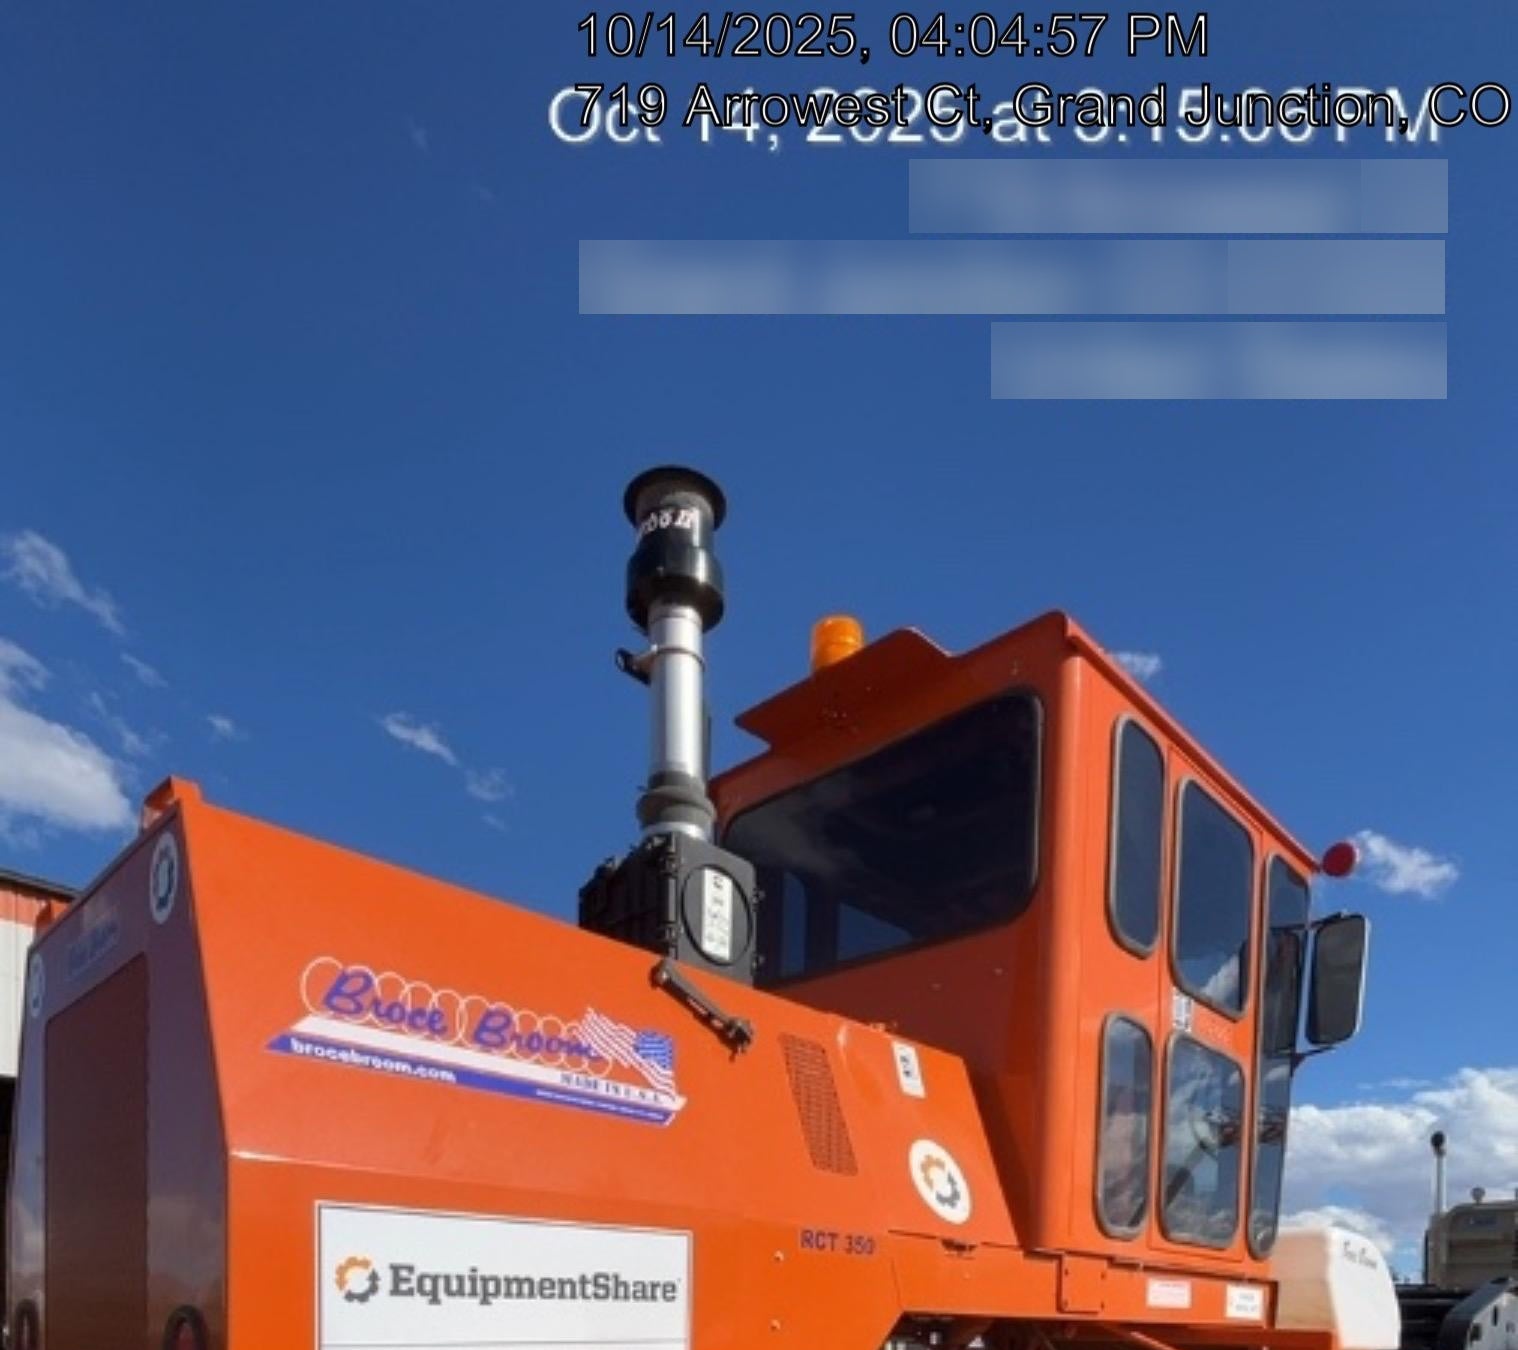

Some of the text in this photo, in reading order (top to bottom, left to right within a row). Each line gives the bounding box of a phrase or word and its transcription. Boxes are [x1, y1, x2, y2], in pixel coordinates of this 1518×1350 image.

[324, 968, 449, 1036] Broce
[290, 1036, 457, 1084] brocebroom.com
[800, 1228, 876, 1256] RCT 350
[389, 1263, 677, 1305] EquipmentShare
